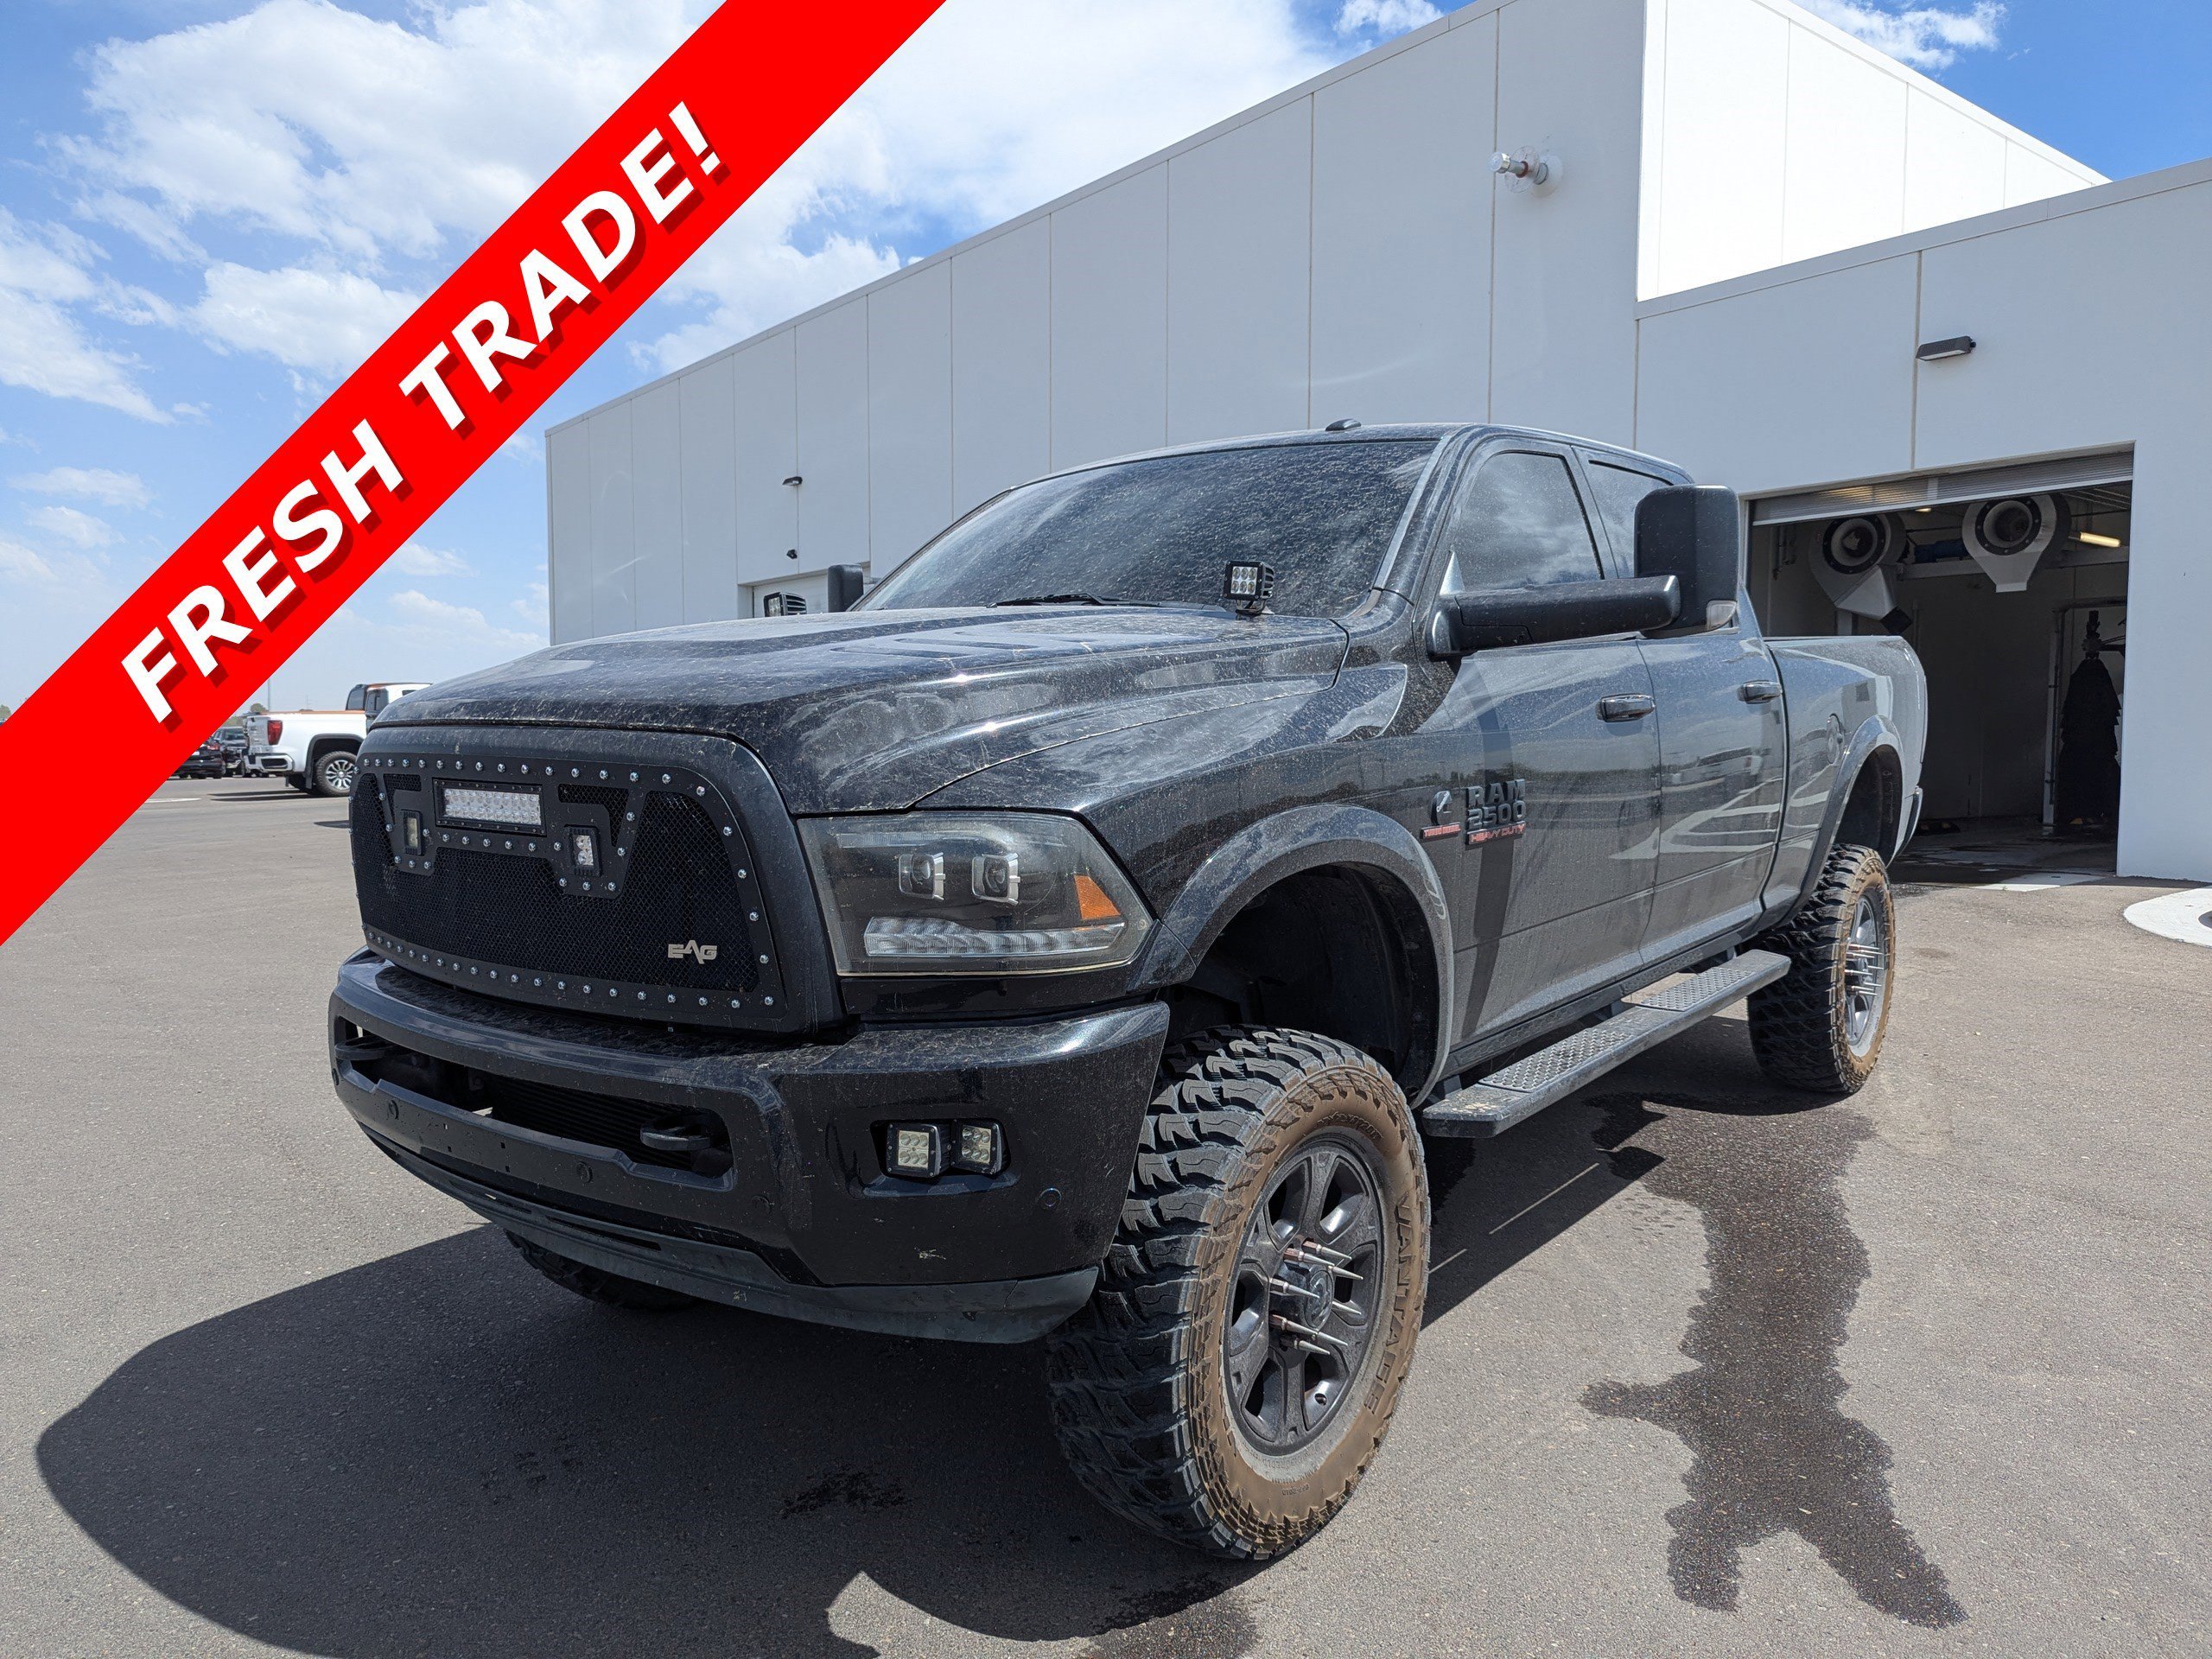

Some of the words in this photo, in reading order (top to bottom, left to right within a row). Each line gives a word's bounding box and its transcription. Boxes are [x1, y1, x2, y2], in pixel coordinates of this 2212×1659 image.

[1466, 779, 1525, 806] RAM
[1467, 800, 1526, 830] 2500
[668, 940, 717, 964] EAG
